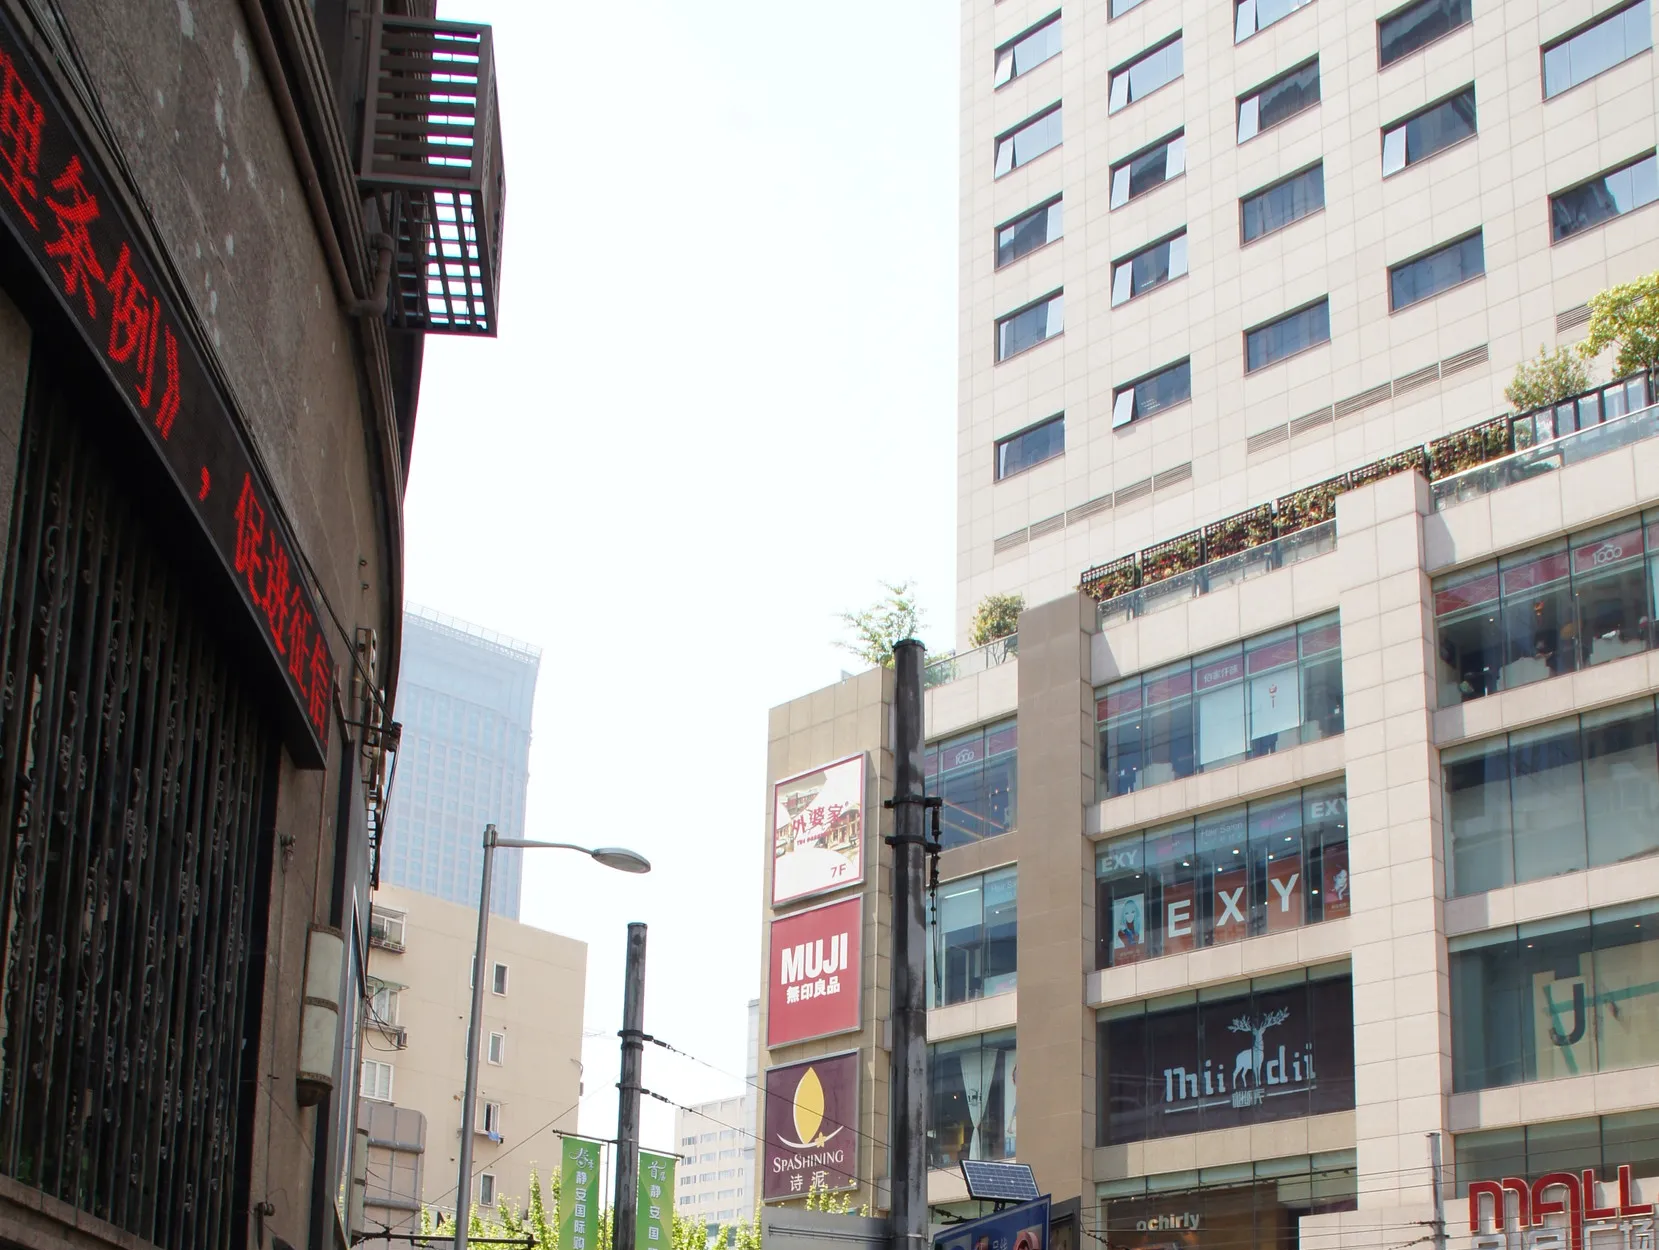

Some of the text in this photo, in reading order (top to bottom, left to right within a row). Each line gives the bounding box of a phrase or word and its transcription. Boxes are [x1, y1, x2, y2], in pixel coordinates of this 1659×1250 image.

[793, 804, 843, 840] 外婆家
[831, 863, 846, 878] 7F
[1102, 849, 1137, 873] EXY
[781, 932, 848, 985] MUJI
[786, 975, 841, 1004] 無印良品
[790, 1170, 827, 1191] 诗泥
[1136, 1212, 1200, 1231] ochirly
